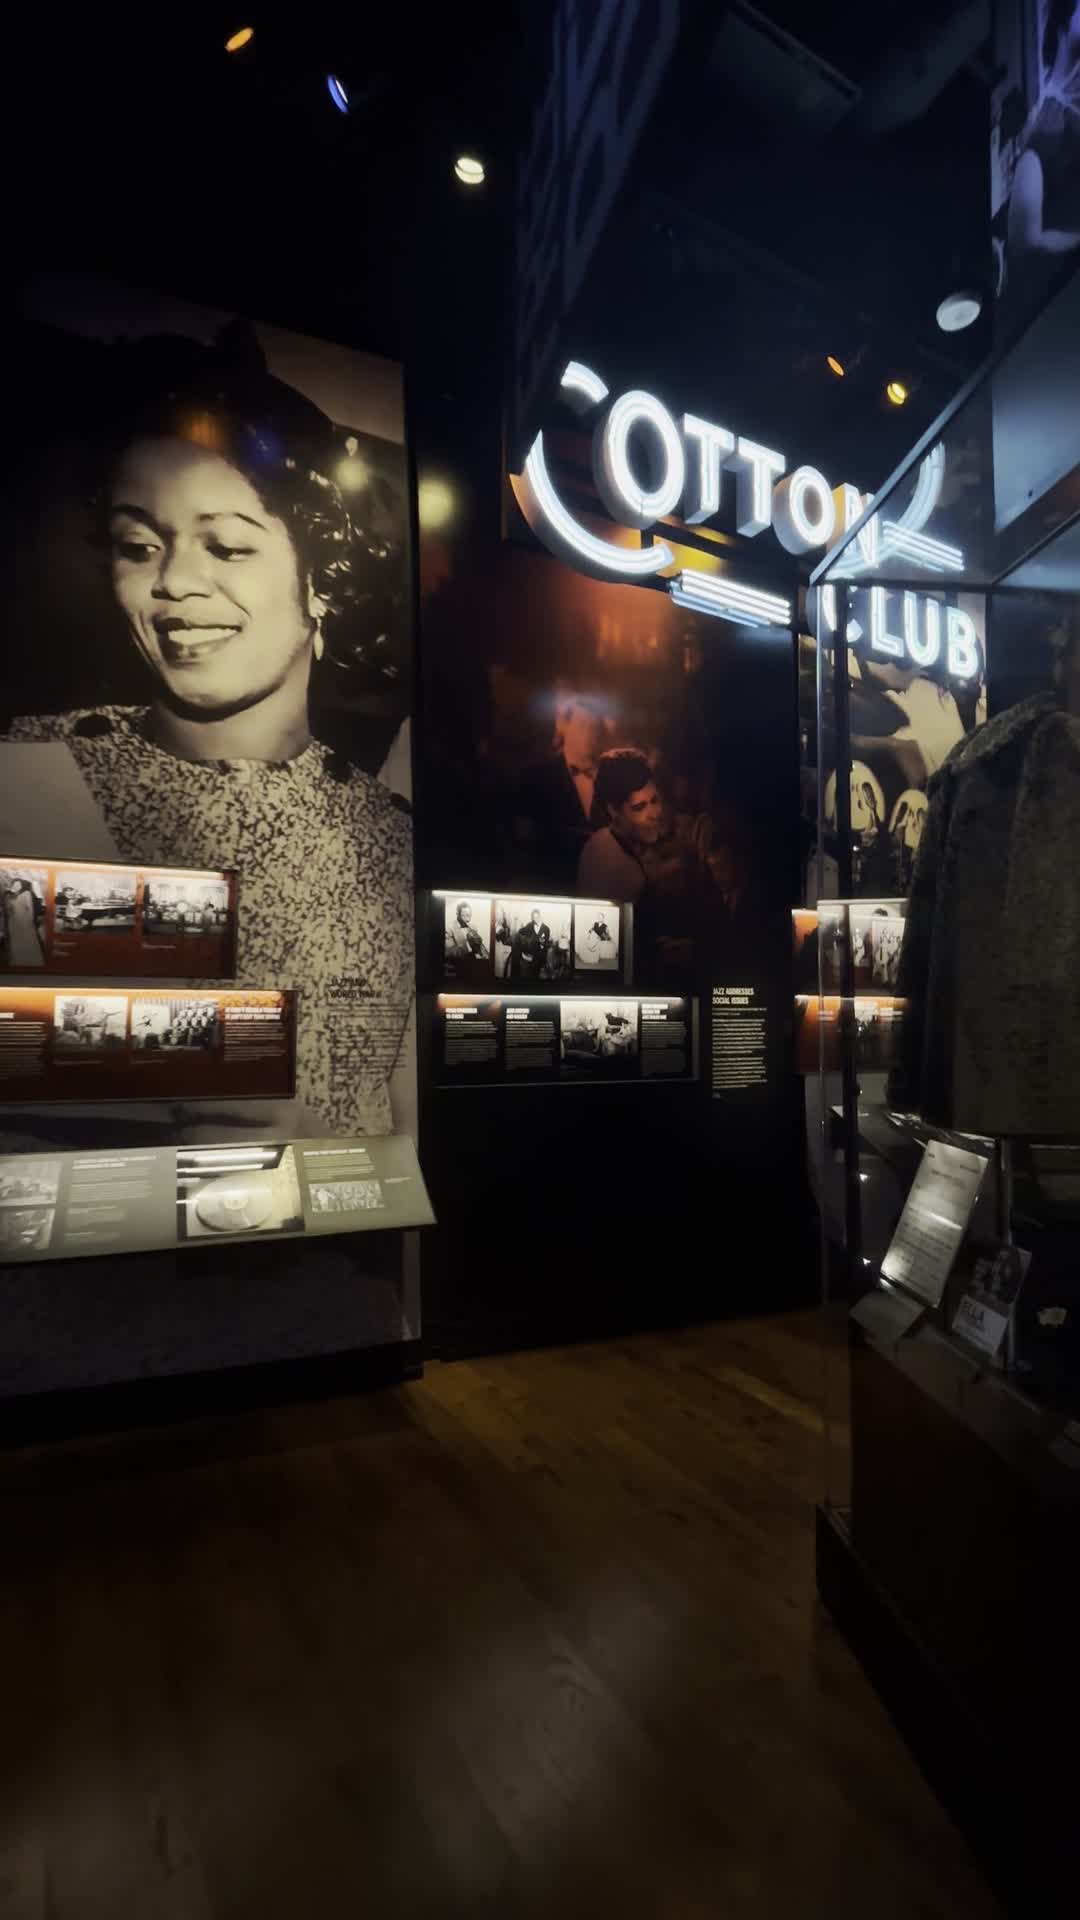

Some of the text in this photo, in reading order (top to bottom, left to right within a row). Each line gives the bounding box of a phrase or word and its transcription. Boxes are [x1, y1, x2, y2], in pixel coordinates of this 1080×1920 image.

[516, 360, 880, 576] COTTON
[713, 987, 754, 996] JAZZ ADDRESSES
[712, 996, 749, 1005] SOCIAL ISSUES
